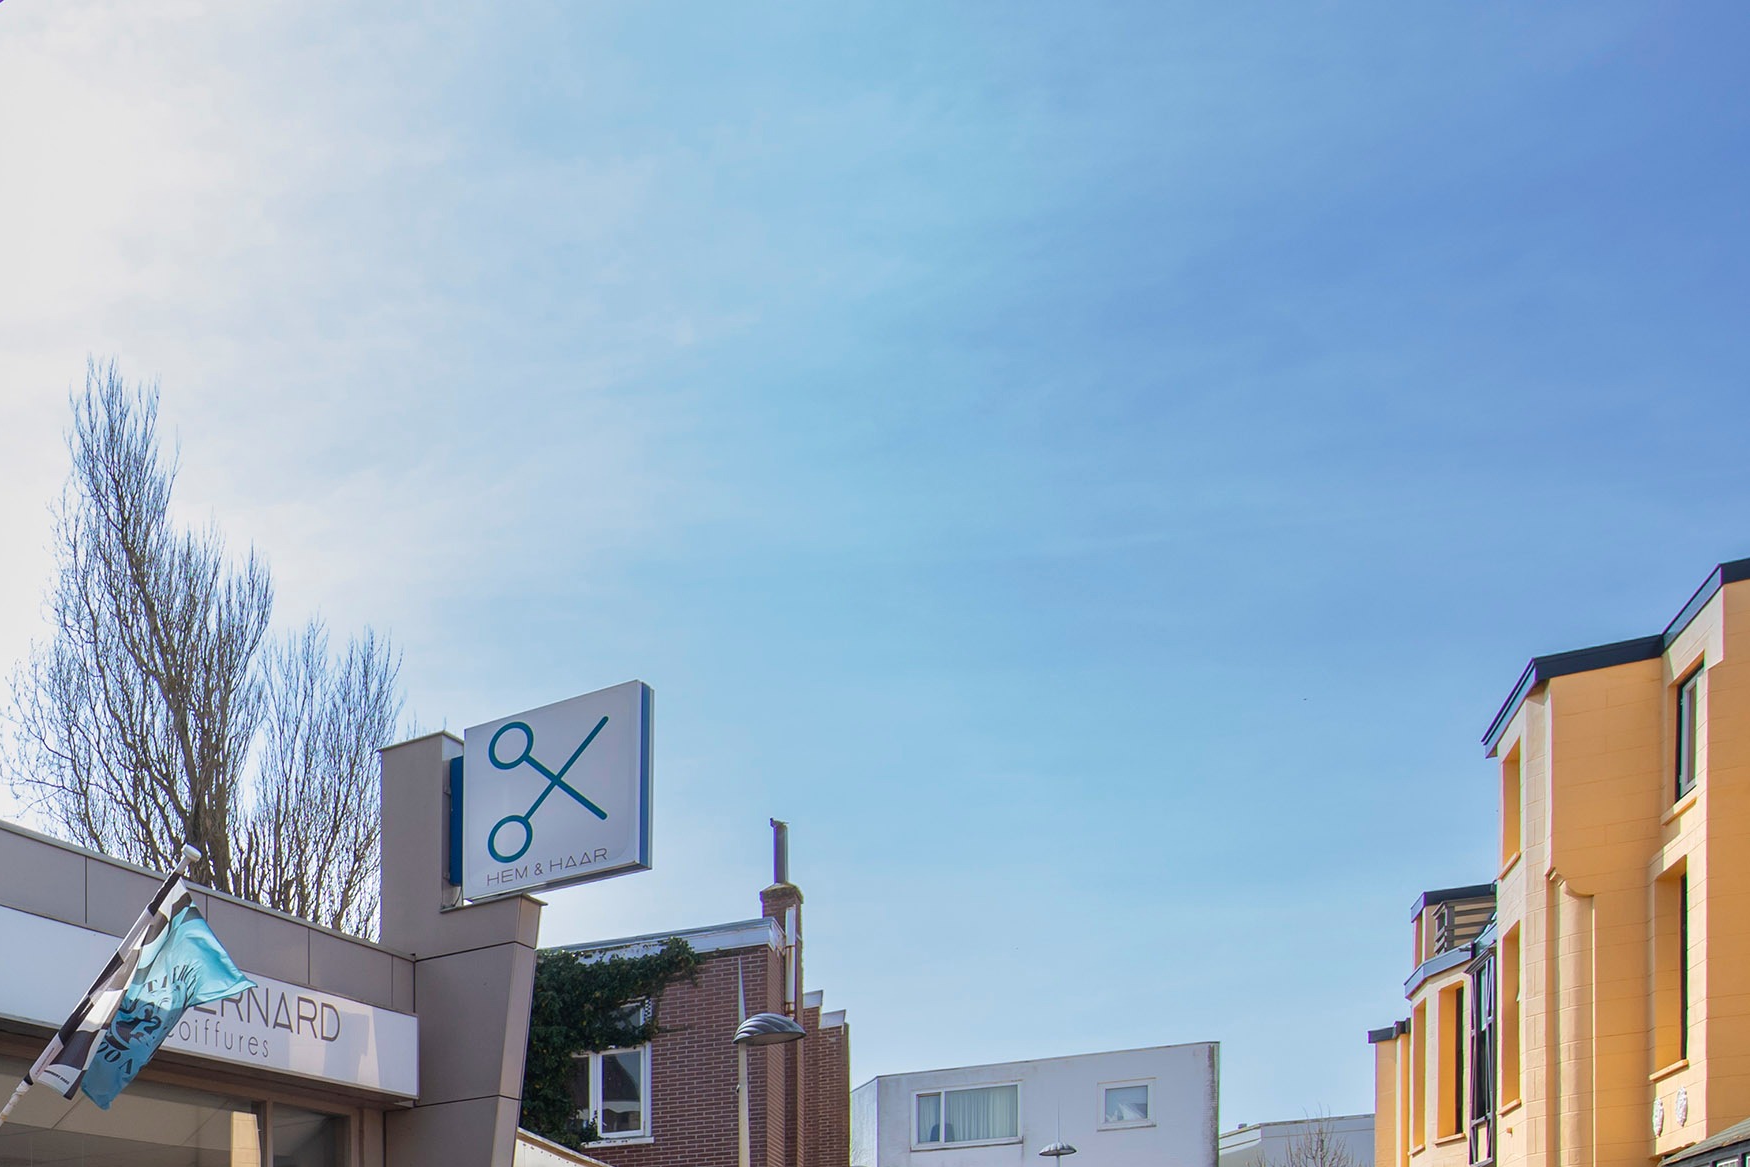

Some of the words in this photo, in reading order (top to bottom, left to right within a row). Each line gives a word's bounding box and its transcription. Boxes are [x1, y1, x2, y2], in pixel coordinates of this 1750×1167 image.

[486, 866, 528, 887] HEM
[533, 862, 544, 876] &
[549, 847, 608, 873] HAAR
[193, 984, 342, 1043] RNARD
[165, 1018, 270, 1058] oiffures
